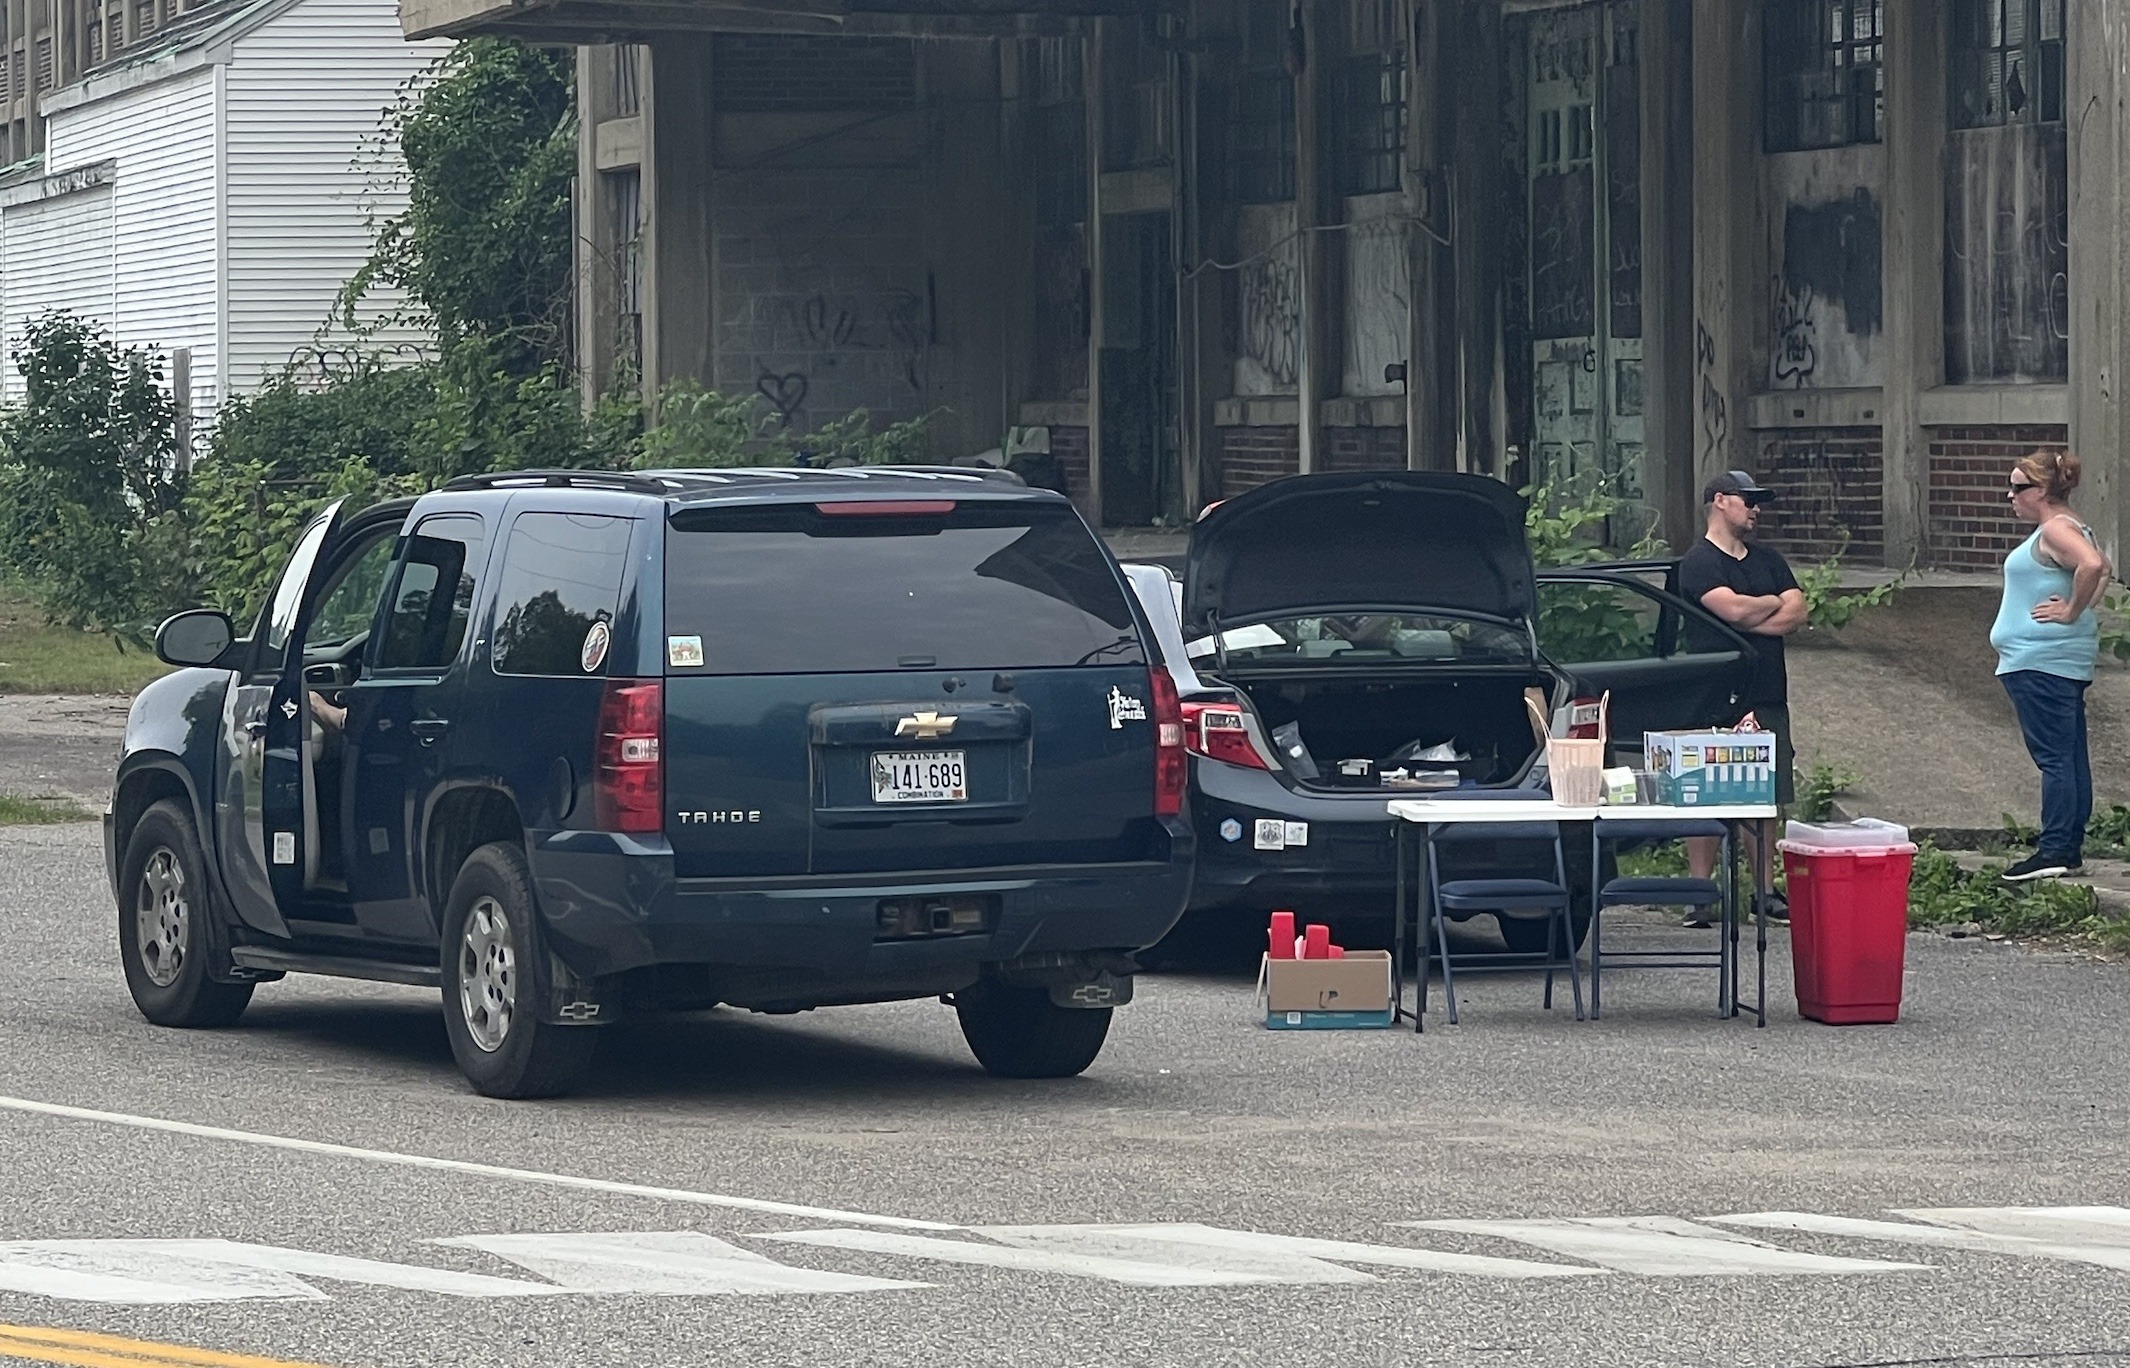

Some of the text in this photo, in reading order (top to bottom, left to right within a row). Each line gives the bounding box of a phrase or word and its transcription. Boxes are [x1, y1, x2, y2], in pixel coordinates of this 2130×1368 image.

[899, 753, 940, 761] MAINE
[897, 790, 944, 800] COMBINATION
[678, 810, 761, 824] TAHOE
